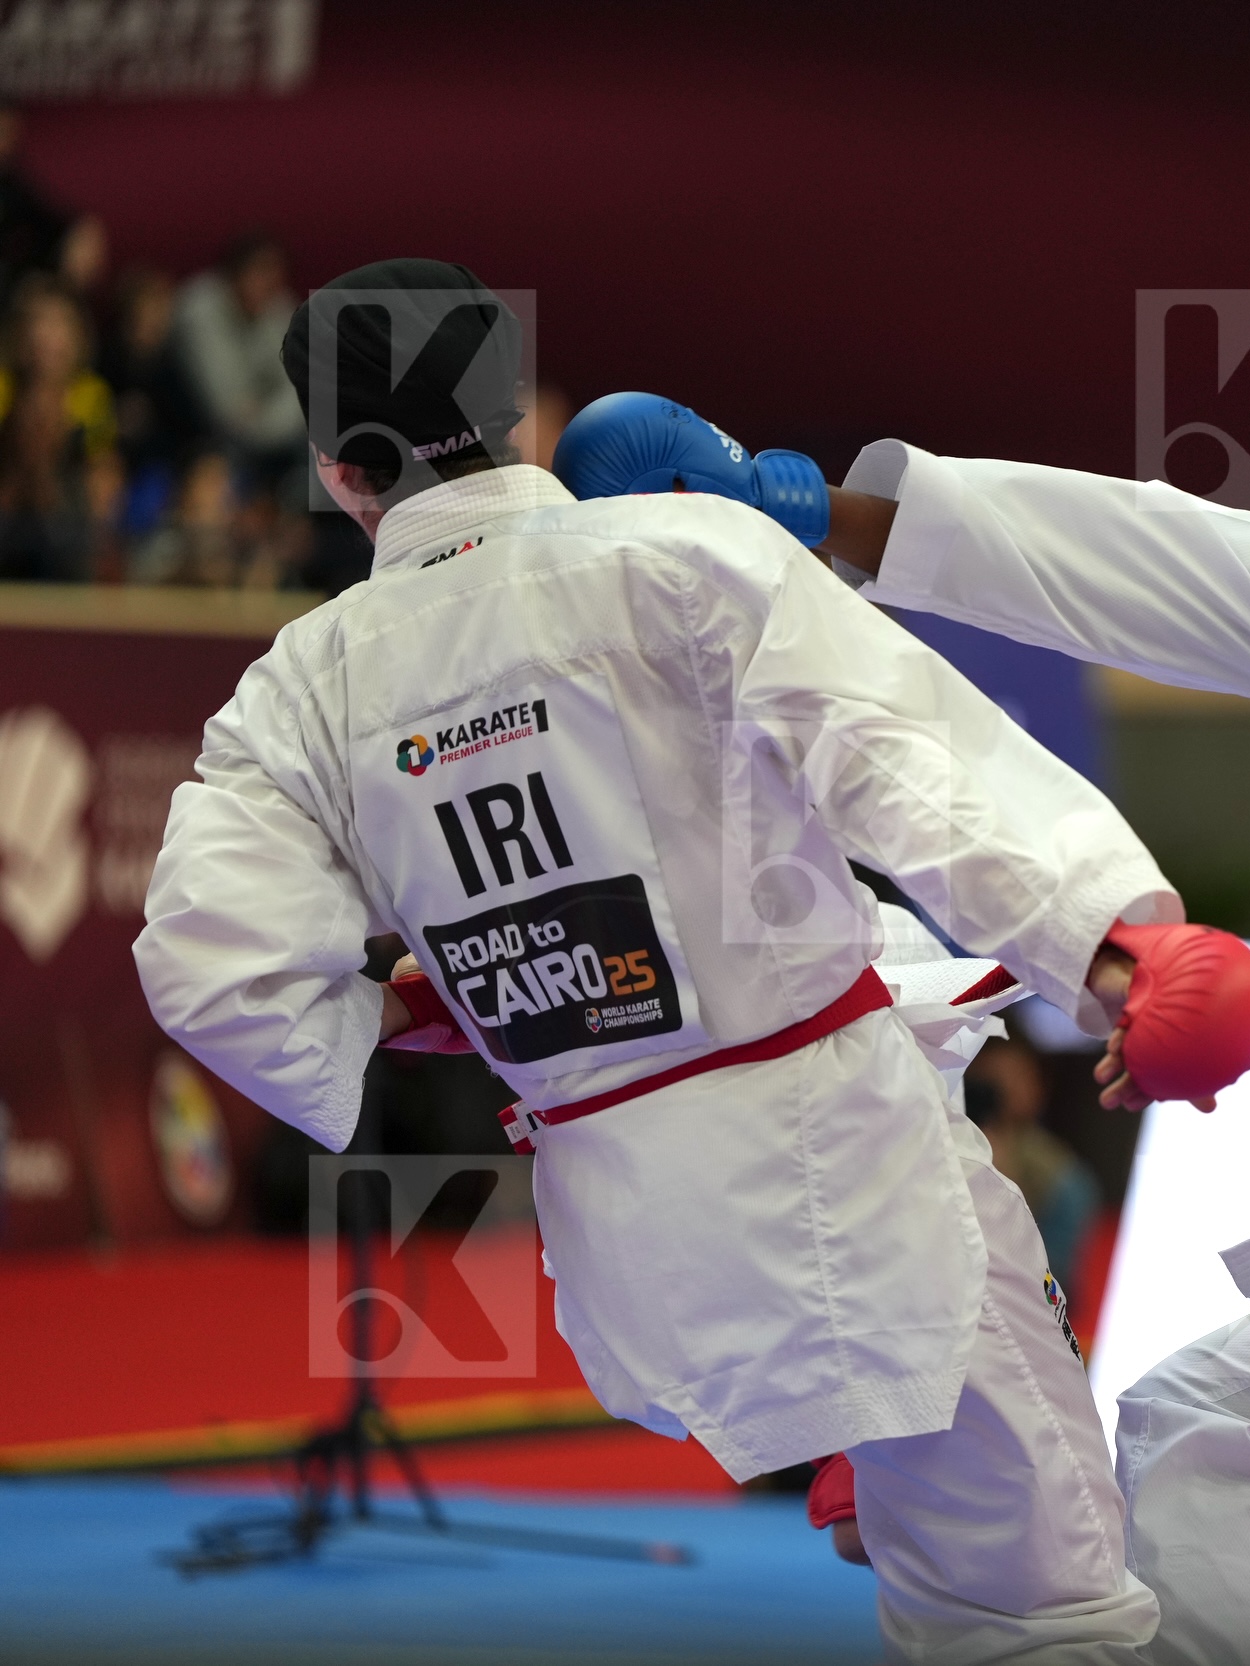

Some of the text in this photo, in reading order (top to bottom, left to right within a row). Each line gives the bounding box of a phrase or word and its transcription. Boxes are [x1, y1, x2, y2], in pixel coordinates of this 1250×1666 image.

[411, 425, 482, 461] SMAI
[439, 726, 533, 765] PREMIER LEAGUE
[434, 771, 574, 898] IRI
[441, 919, 566, 973] ROAD to
[601, 998, 661, 1019] WORLD KARATE
[604, 1009, 663, 1029] CHAMPIONSHIPS
